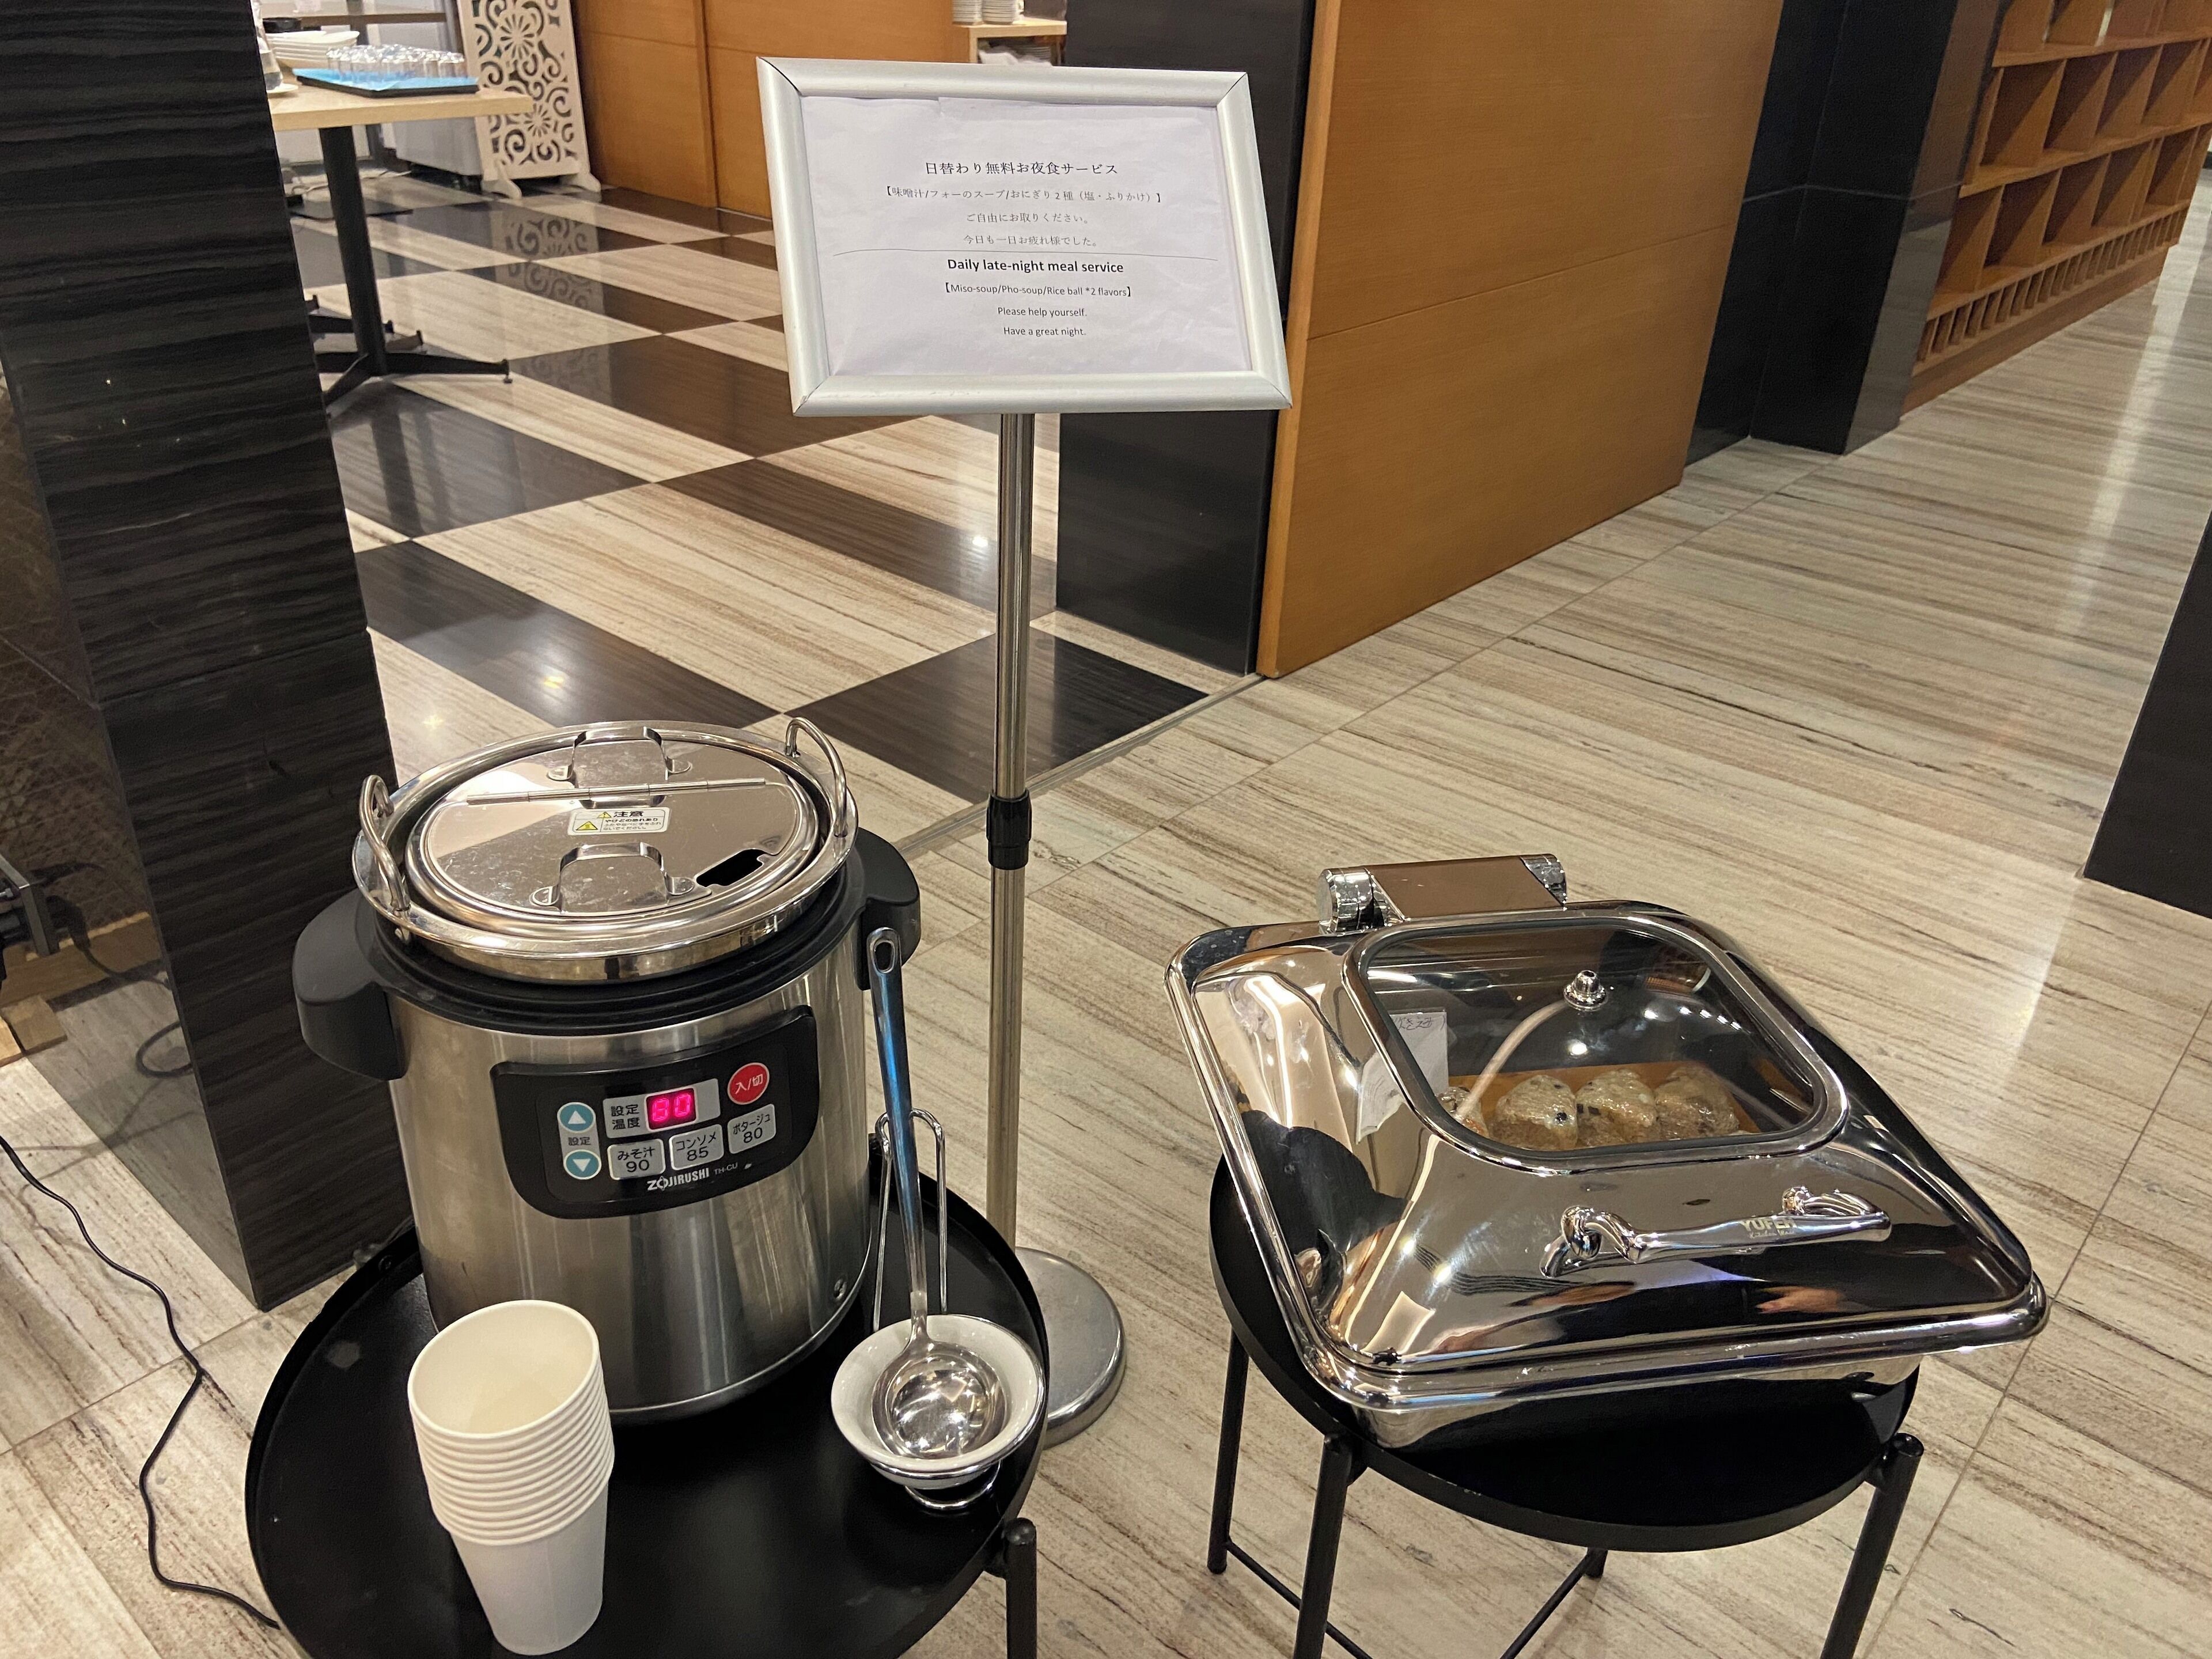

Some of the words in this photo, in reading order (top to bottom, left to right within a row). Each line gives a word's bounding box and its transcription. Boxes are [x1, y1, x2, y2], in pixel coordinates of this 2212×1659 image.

[925, 161, 1118, 175] 日替わり無料お夜食サービス
[966, 212, 1088, 225] ご自由にお取りください。
[963, 234, 1097, 247] 今日も一日お疲れ様でした。
[947, 259, 979, 272] Daily
[983, 259, 1044, 273] late-night
[1048, 260, 1078, 271] meal
[1081, 262, 1124, 272] service
[1067, 286, 1083, 296] ball
[997, 307, 1026, 316] Please
[1028, 307, 1048, 318] help
[1049, 308, 1088, 318] yourself.
[1003, 327, 1026, 335] Have
[1035, 328, 1059, 338] great
[1061, 328, 1087, 337] night.
[735, 1073, 763, 1094] 入/切
[611, 1104, 639, 1116] 設定
[652, 1093, 692, 1122] 80
[612, 1117, 641, 1130] 温度
[733, 1113, 771, 1135] ポタージュ
[568, 1137, 591, 1146] 設定
[676, 1131, 717, 1151] コンソメ
[743, 1127, 763, 1143] 80
[617, 1146, 656, 1160] みそ汁
[687, 1146, 709, 1161] 85
[626, 1160, 650, 1173] 90
[647, 1167, 710, 1191] ZOJIRUSHI
